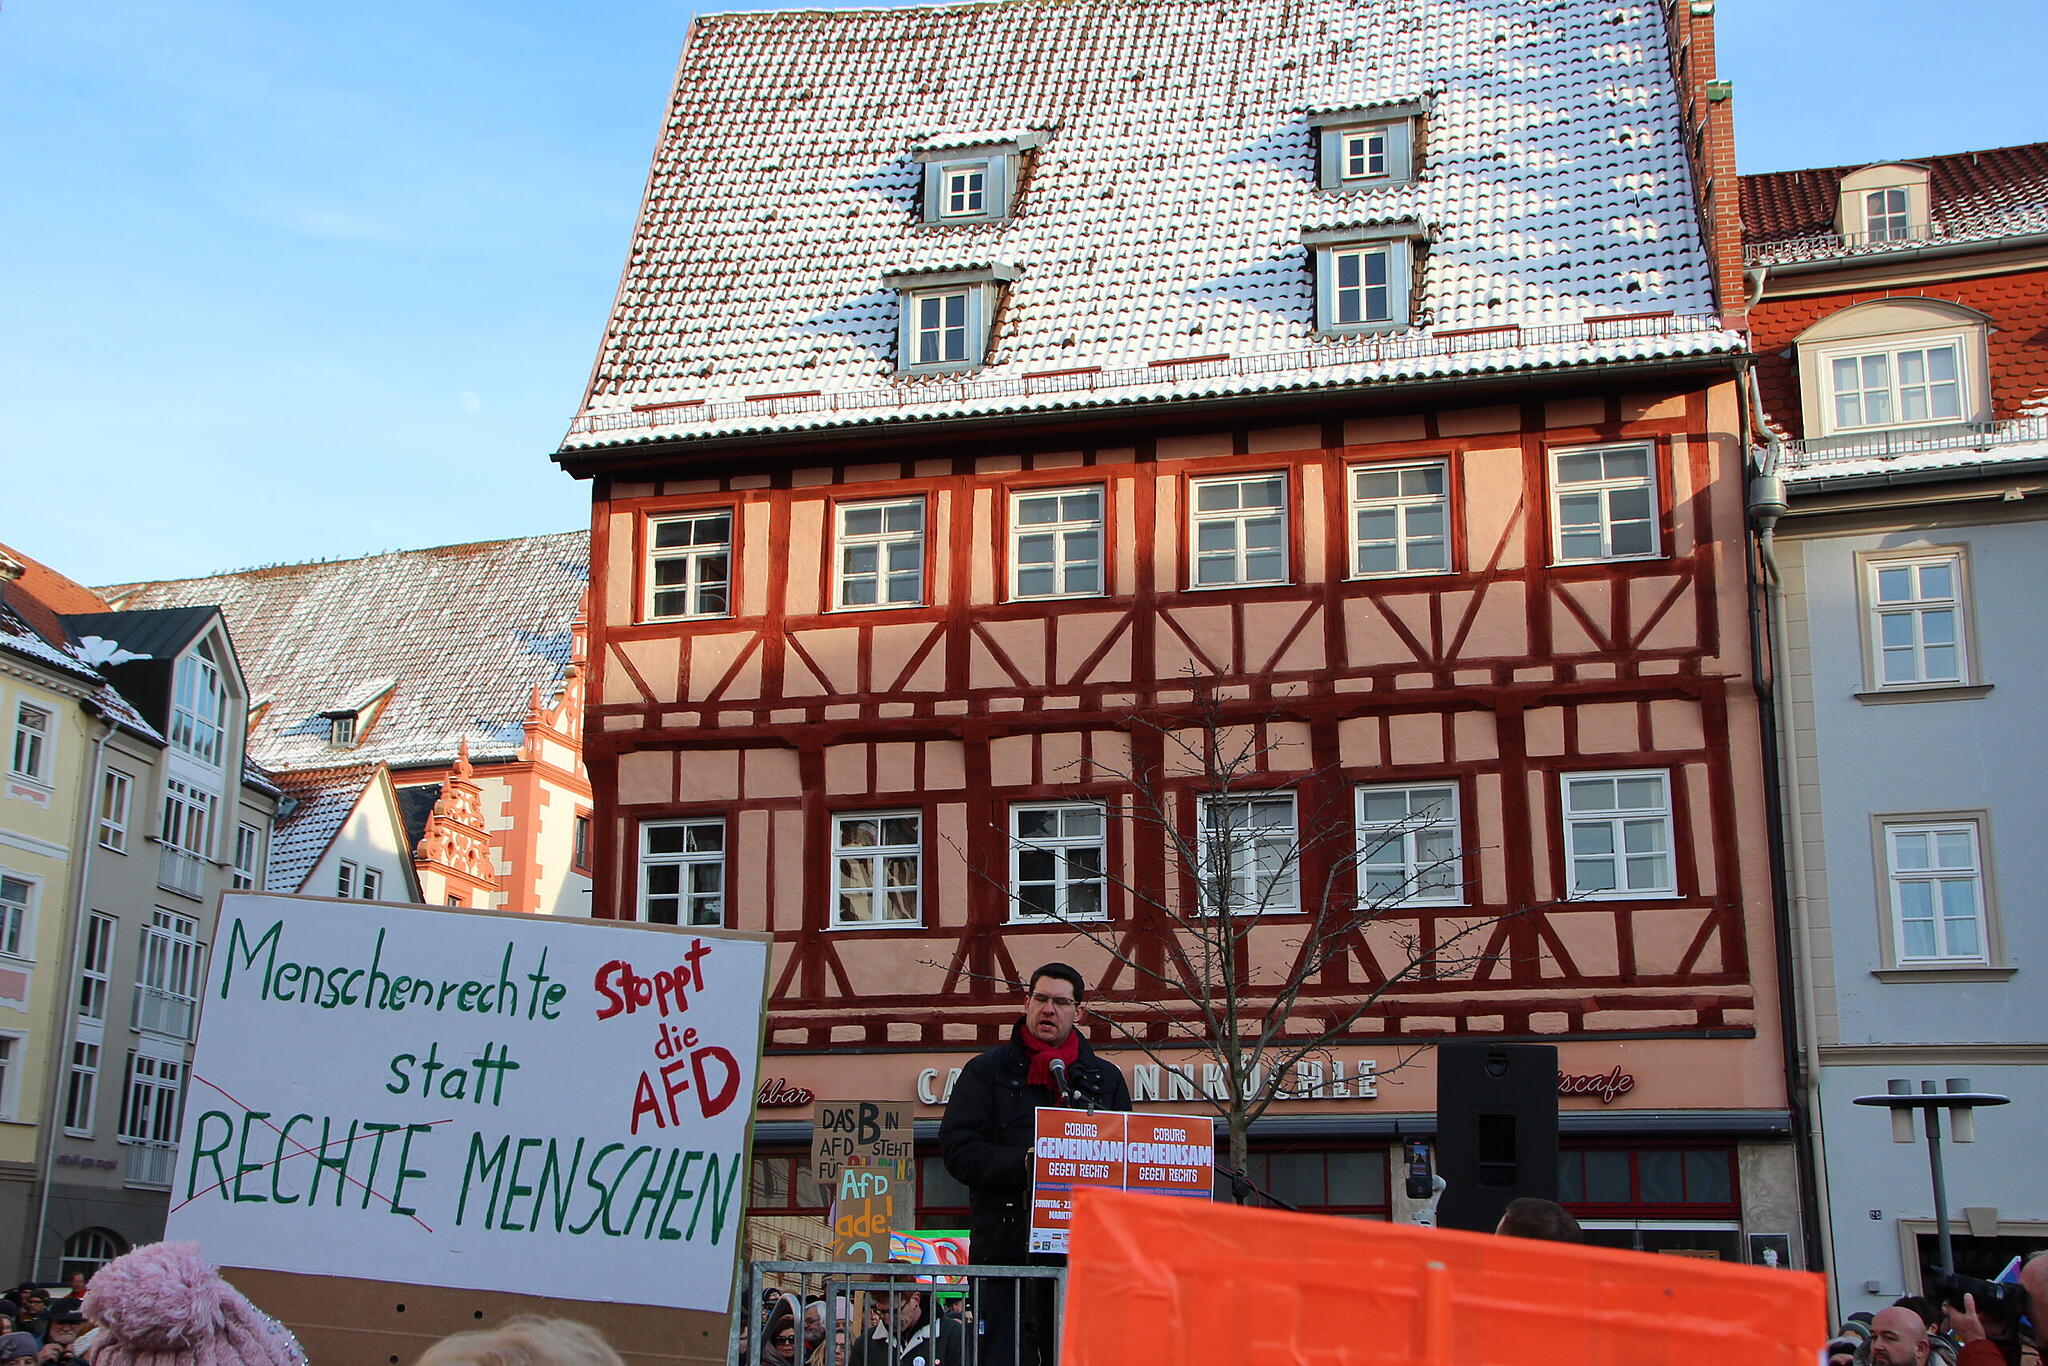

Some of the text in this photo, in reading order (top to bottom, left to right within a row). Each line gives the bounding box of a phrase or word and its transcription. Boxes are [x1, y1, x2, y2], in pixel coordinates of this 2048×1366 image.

[219, 917, 567, 1021] Menschenrechte
[595, 939, 712, 1020] Stoppt
[655, 1023, 700, 1060] die
[384, 1041, 521, 1107] statt
[630, 1045, 741, 1135] AFD
[1558, 1065, 1635, 1104] scafe
[822, 1101, 900, 1147] DAS B IN
[1064, 1122, 1098, 1138] COBURG
[1153, 1127, 1186, 1143] COBURG
[819, 1137, 913, 1158] AFD STEHT
[1037, 1136, 1125, 1162] GEMEINSAM
[1127, 1141, 1212, 1167] GEMEINSAM
[187, 1109, 742, 1246] RECHTE MENSCHEN
[840, 1169, 889, 1201] AfD
[1048, 1162, 1110, 1179] GEGEN RECHTS
[1138, 1167, 1198, 1183] GEGEN RECHTS
[835, 1195, 894, 1238] ade!
